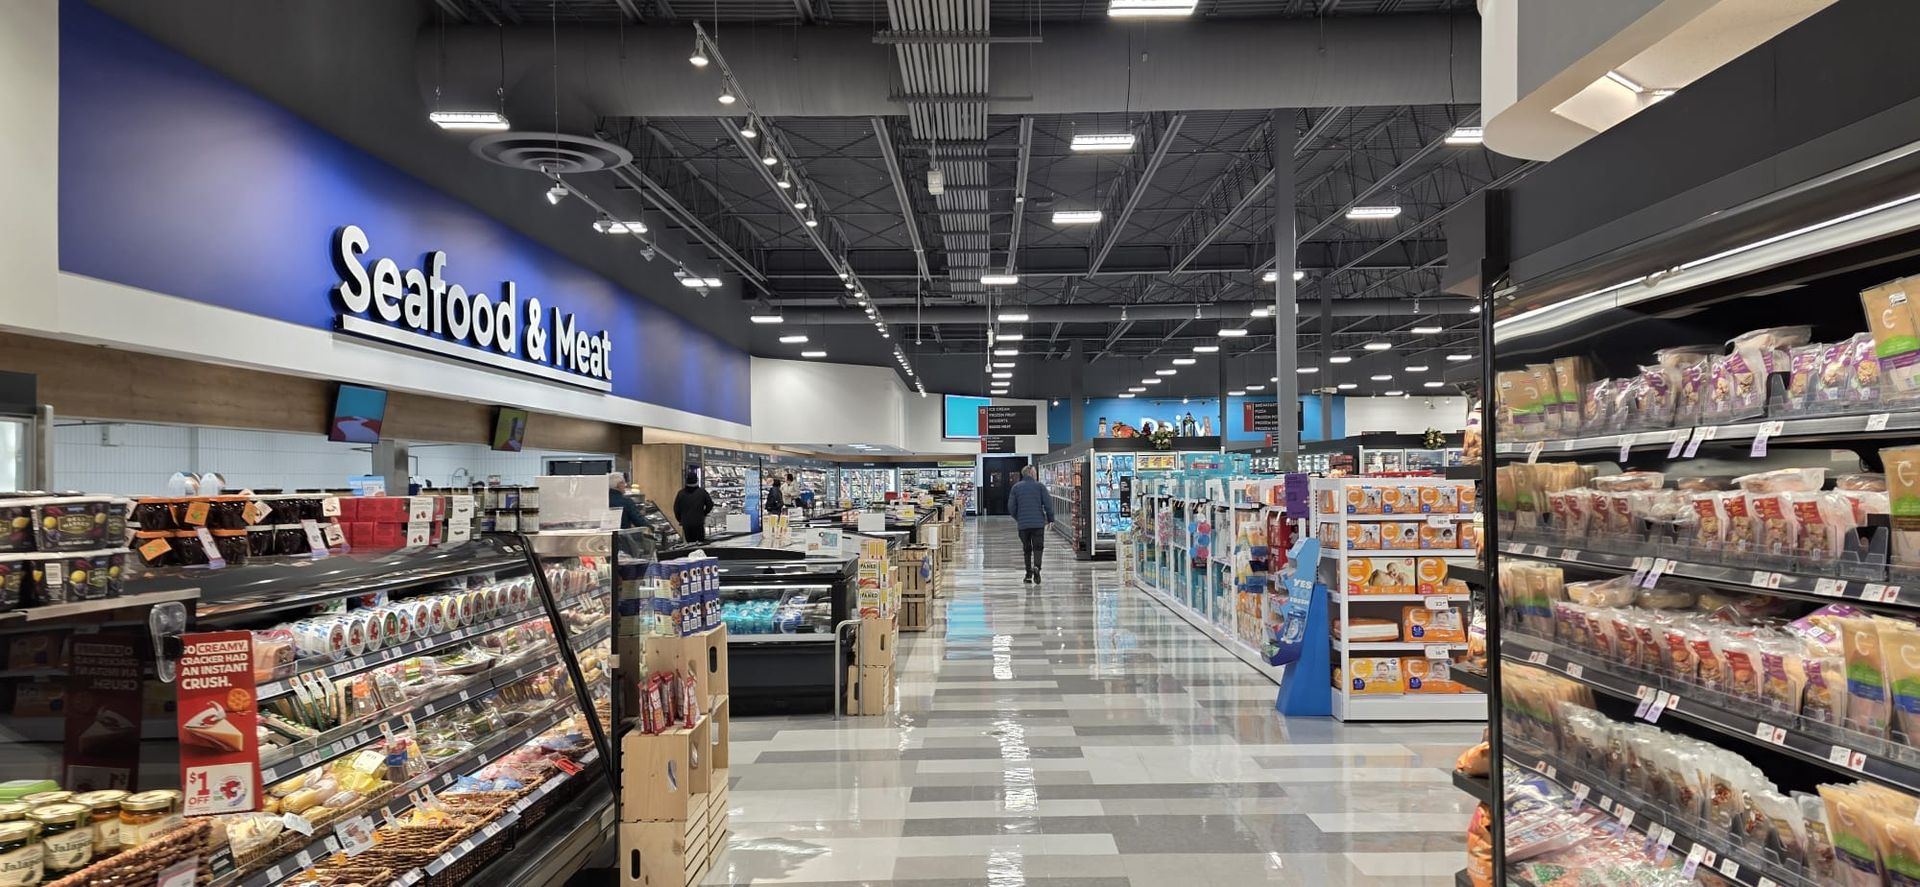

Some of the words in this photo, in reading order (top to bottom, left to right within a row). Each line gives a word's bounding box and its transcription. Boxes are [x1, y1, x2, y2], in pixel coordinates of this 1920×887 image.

[339, 224, 515, 354] Seafood
[527, 297, 547, 362] &
[552, 306, 612, 380] Meat
[198, 641, 247, 653] CREAMY.
[181, 654, 224, 666] CRACKER
[225, 653, 248, 662] HAD
[181, 666, 200, 677] AN
[200, 662, 249, 675] INSTANT
[182, 676, 233, 690] CRUSH.
[189, 796, 209, 805] OFF
